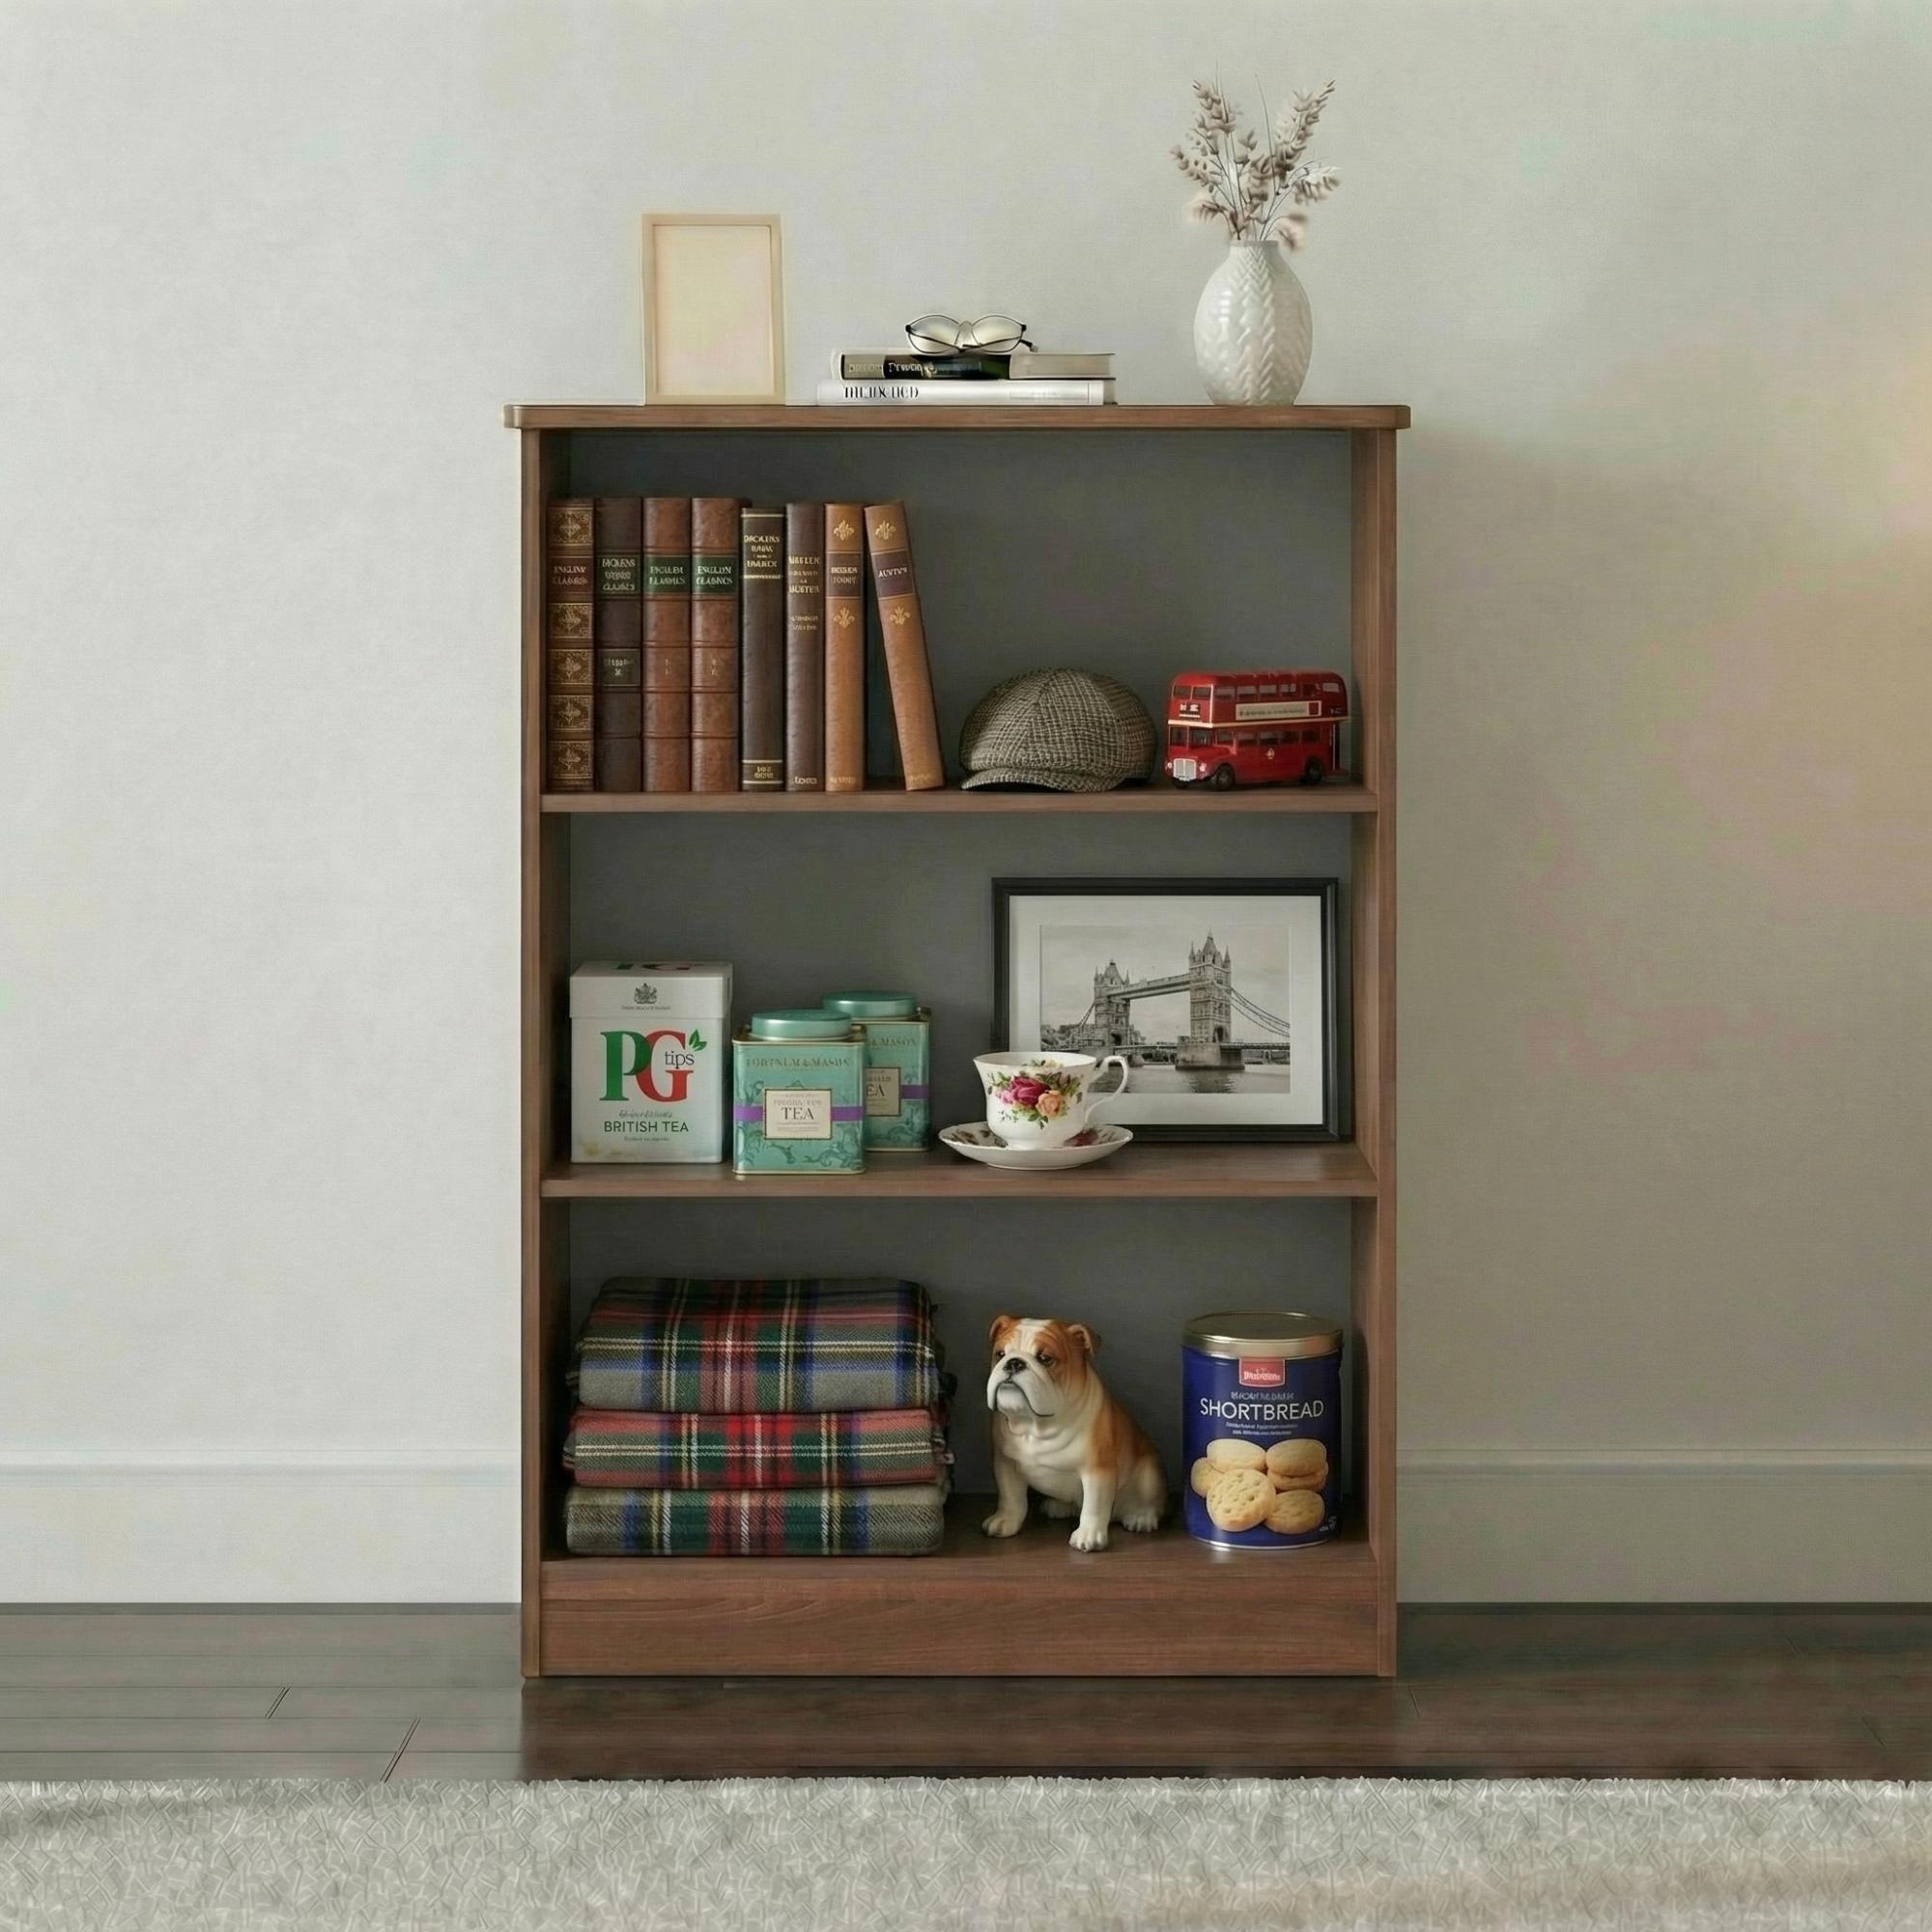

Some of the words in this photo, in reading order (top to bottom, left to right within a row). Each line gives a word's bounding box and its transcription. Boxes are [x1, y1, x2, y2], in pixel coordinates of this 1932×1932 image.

[599, 1030, 694, 1102] PG
[665, 1050, 695, 1068] tips
[866, 1083, 885, 1096] EA
[781, 1106, 814, 1121] TEA
[604, 1121, 658, 1132] BRITISH
[662, 1121, 689, 1132] TEA
[1200, 1397, 1324, 1421] SHORTBREAD
